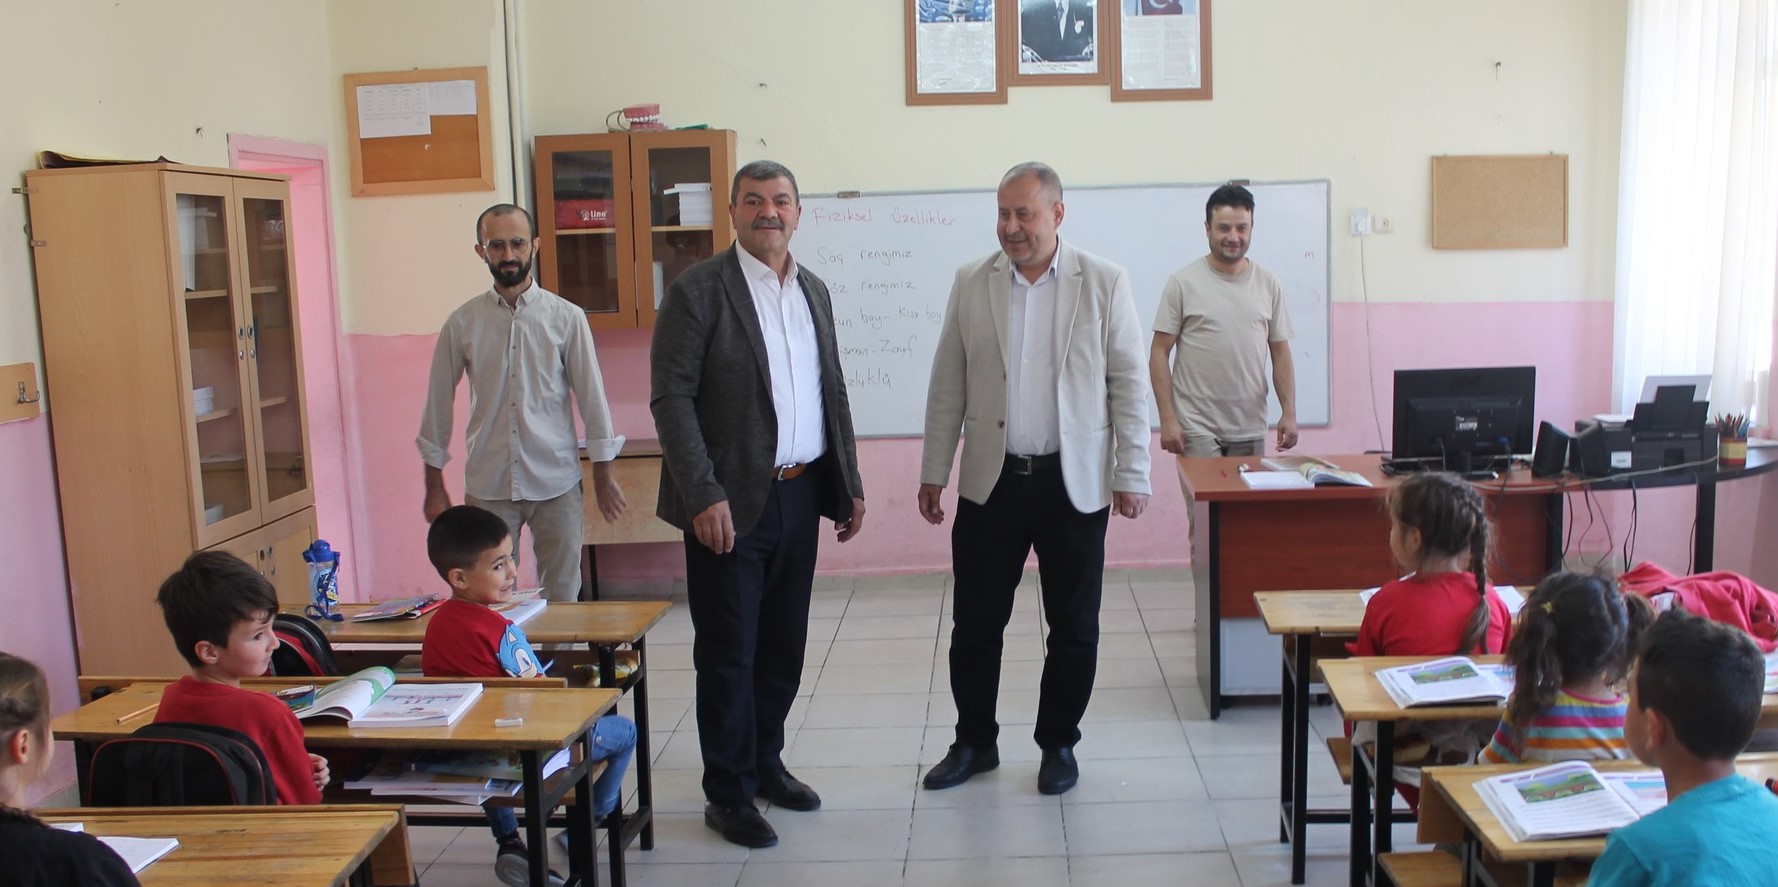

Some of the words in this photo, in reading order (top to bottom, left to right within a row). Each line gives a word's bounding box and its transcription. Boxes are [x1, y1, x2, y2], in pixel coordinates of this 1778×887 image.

[811, 206, 873, 227] Fiziksel
[860, 247, 913, 266] rengimiz
[824, 279, 849, 294] öz
[861, 279, 916, 296] rengimiz
